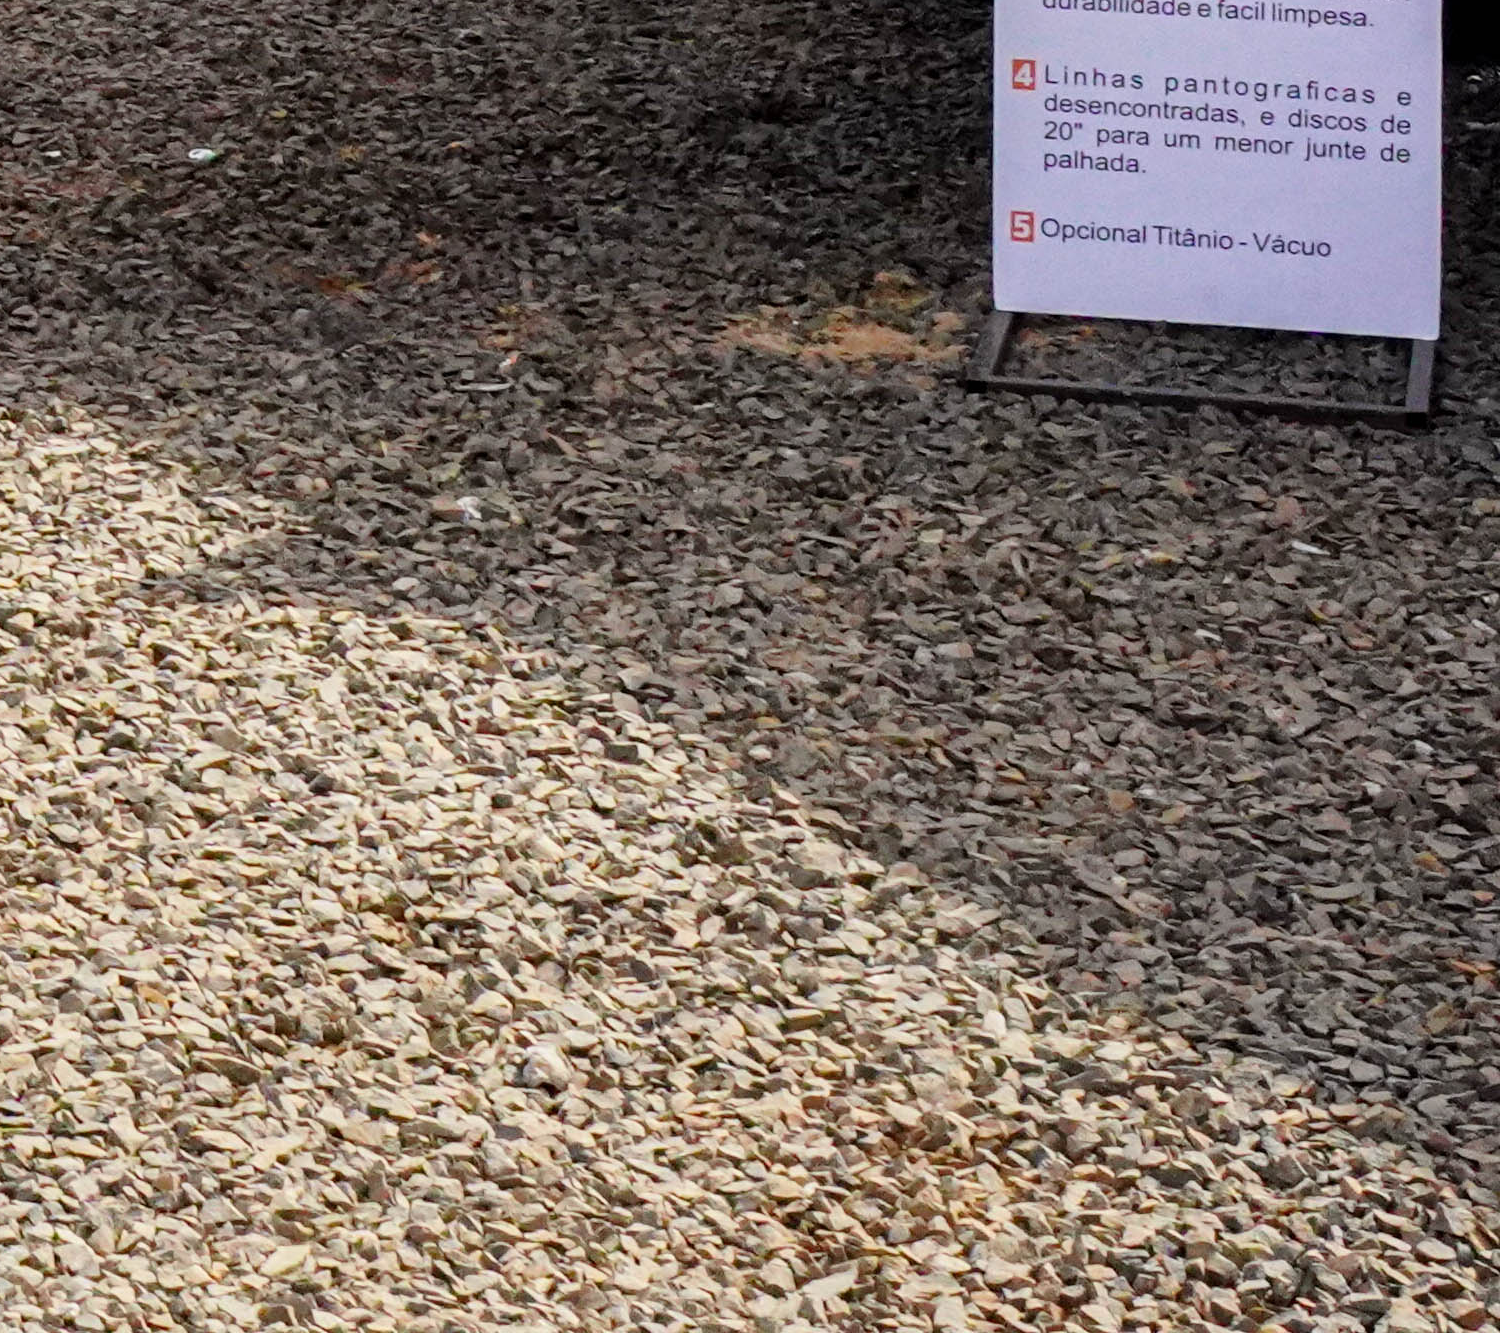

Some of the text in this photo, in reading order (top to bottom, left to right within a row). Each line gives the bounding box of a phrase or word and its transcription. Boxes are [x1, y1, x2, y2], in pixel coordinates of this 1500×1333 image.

[1196, 2, 1212, 19] e
[1271, 2, 1375, 29] limpesa.
[1044, 64, 1412, 107] Linhas pantograficas e
[1043, 93, 1412, 136] desencontradas, e discos de
[1043, 150, 1147, 174] palhada.
[1096, 128, 1150, 148] para
[1163, 132, 1201, 150] um
[1214, 136, 1295, 155] menor
[1303, 137, 1367, 162] junte
[1379, 142, 1411, 164] de
[1040, 217, 1332, 258] Opcional Titânio Vácuo
